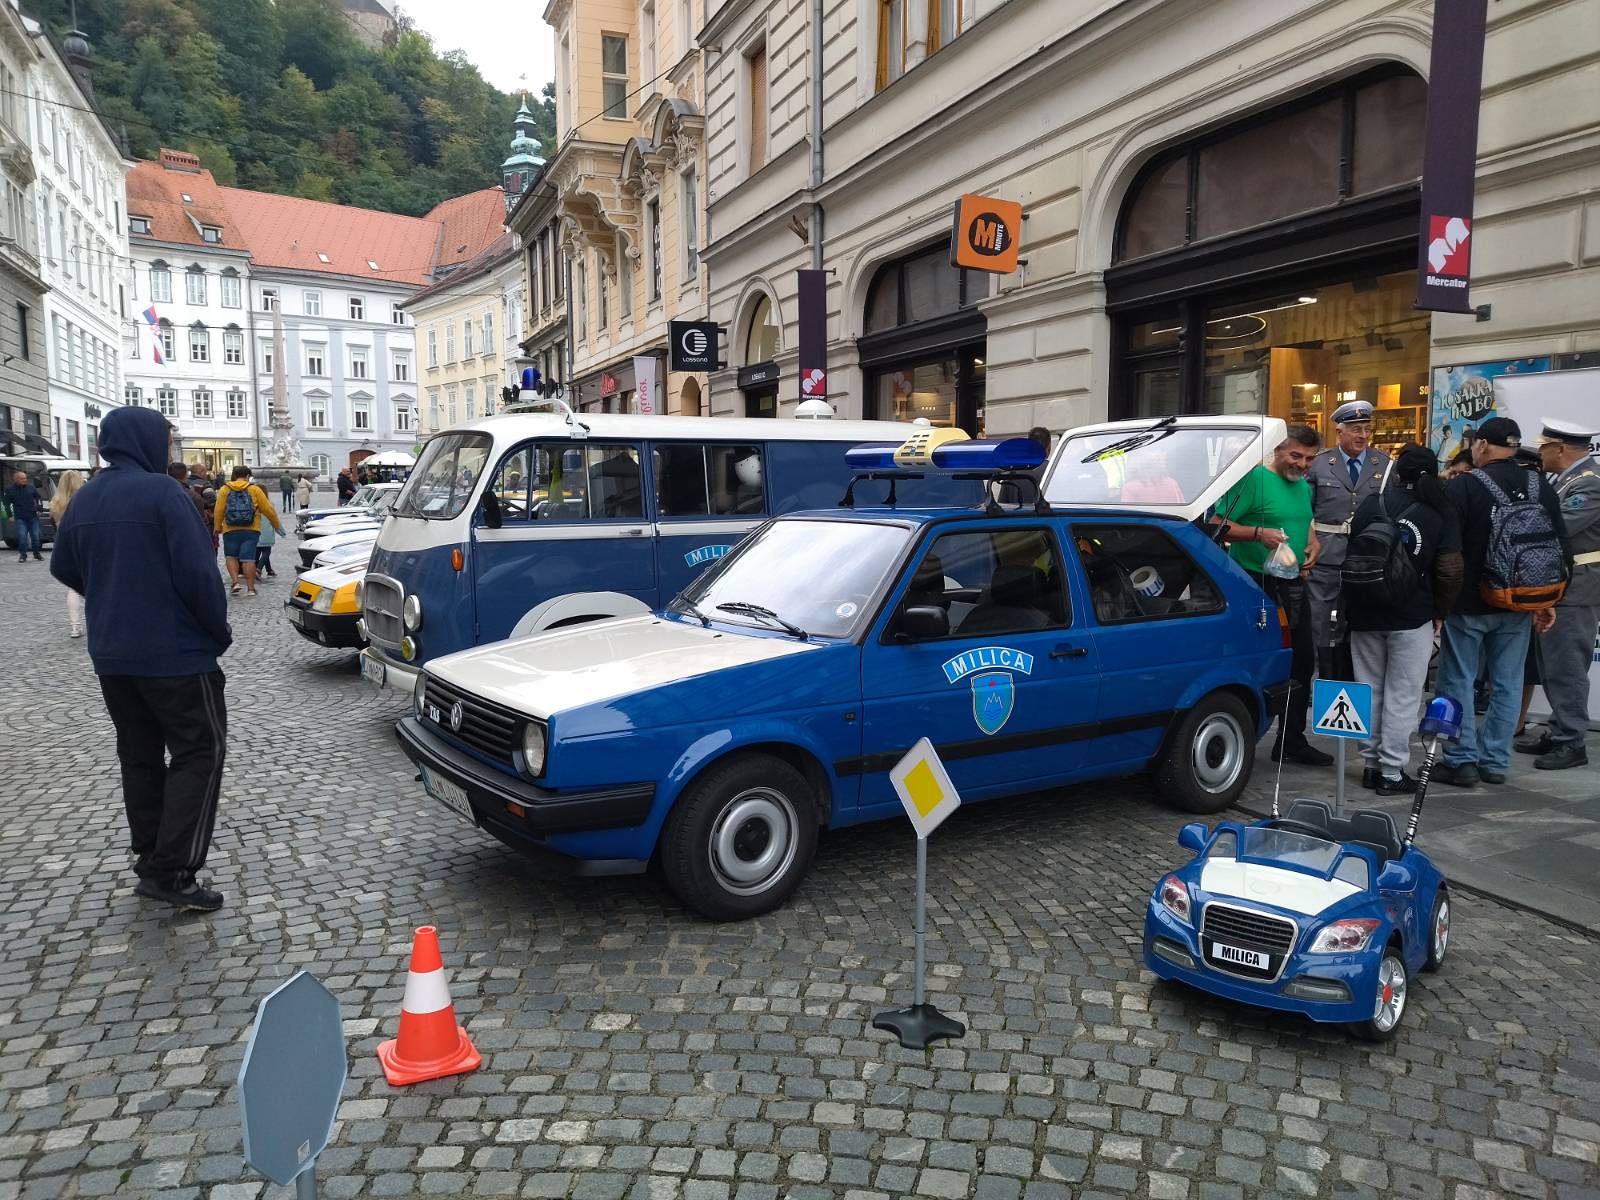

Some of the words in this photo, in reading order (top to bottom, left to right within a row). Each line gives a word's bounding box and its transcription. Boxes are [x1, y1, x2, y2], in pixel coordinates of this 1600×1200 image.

[994, 223, 1004, 251] MINUTE
[1426, 275, 1467, 288] Mercator
[1475, 395, 1492, 412] BO
[691, 546, 732, 562] MILI
[951, 649, 1025, 676] MILICA
[1221, 946, 1260, 966] MILICA
